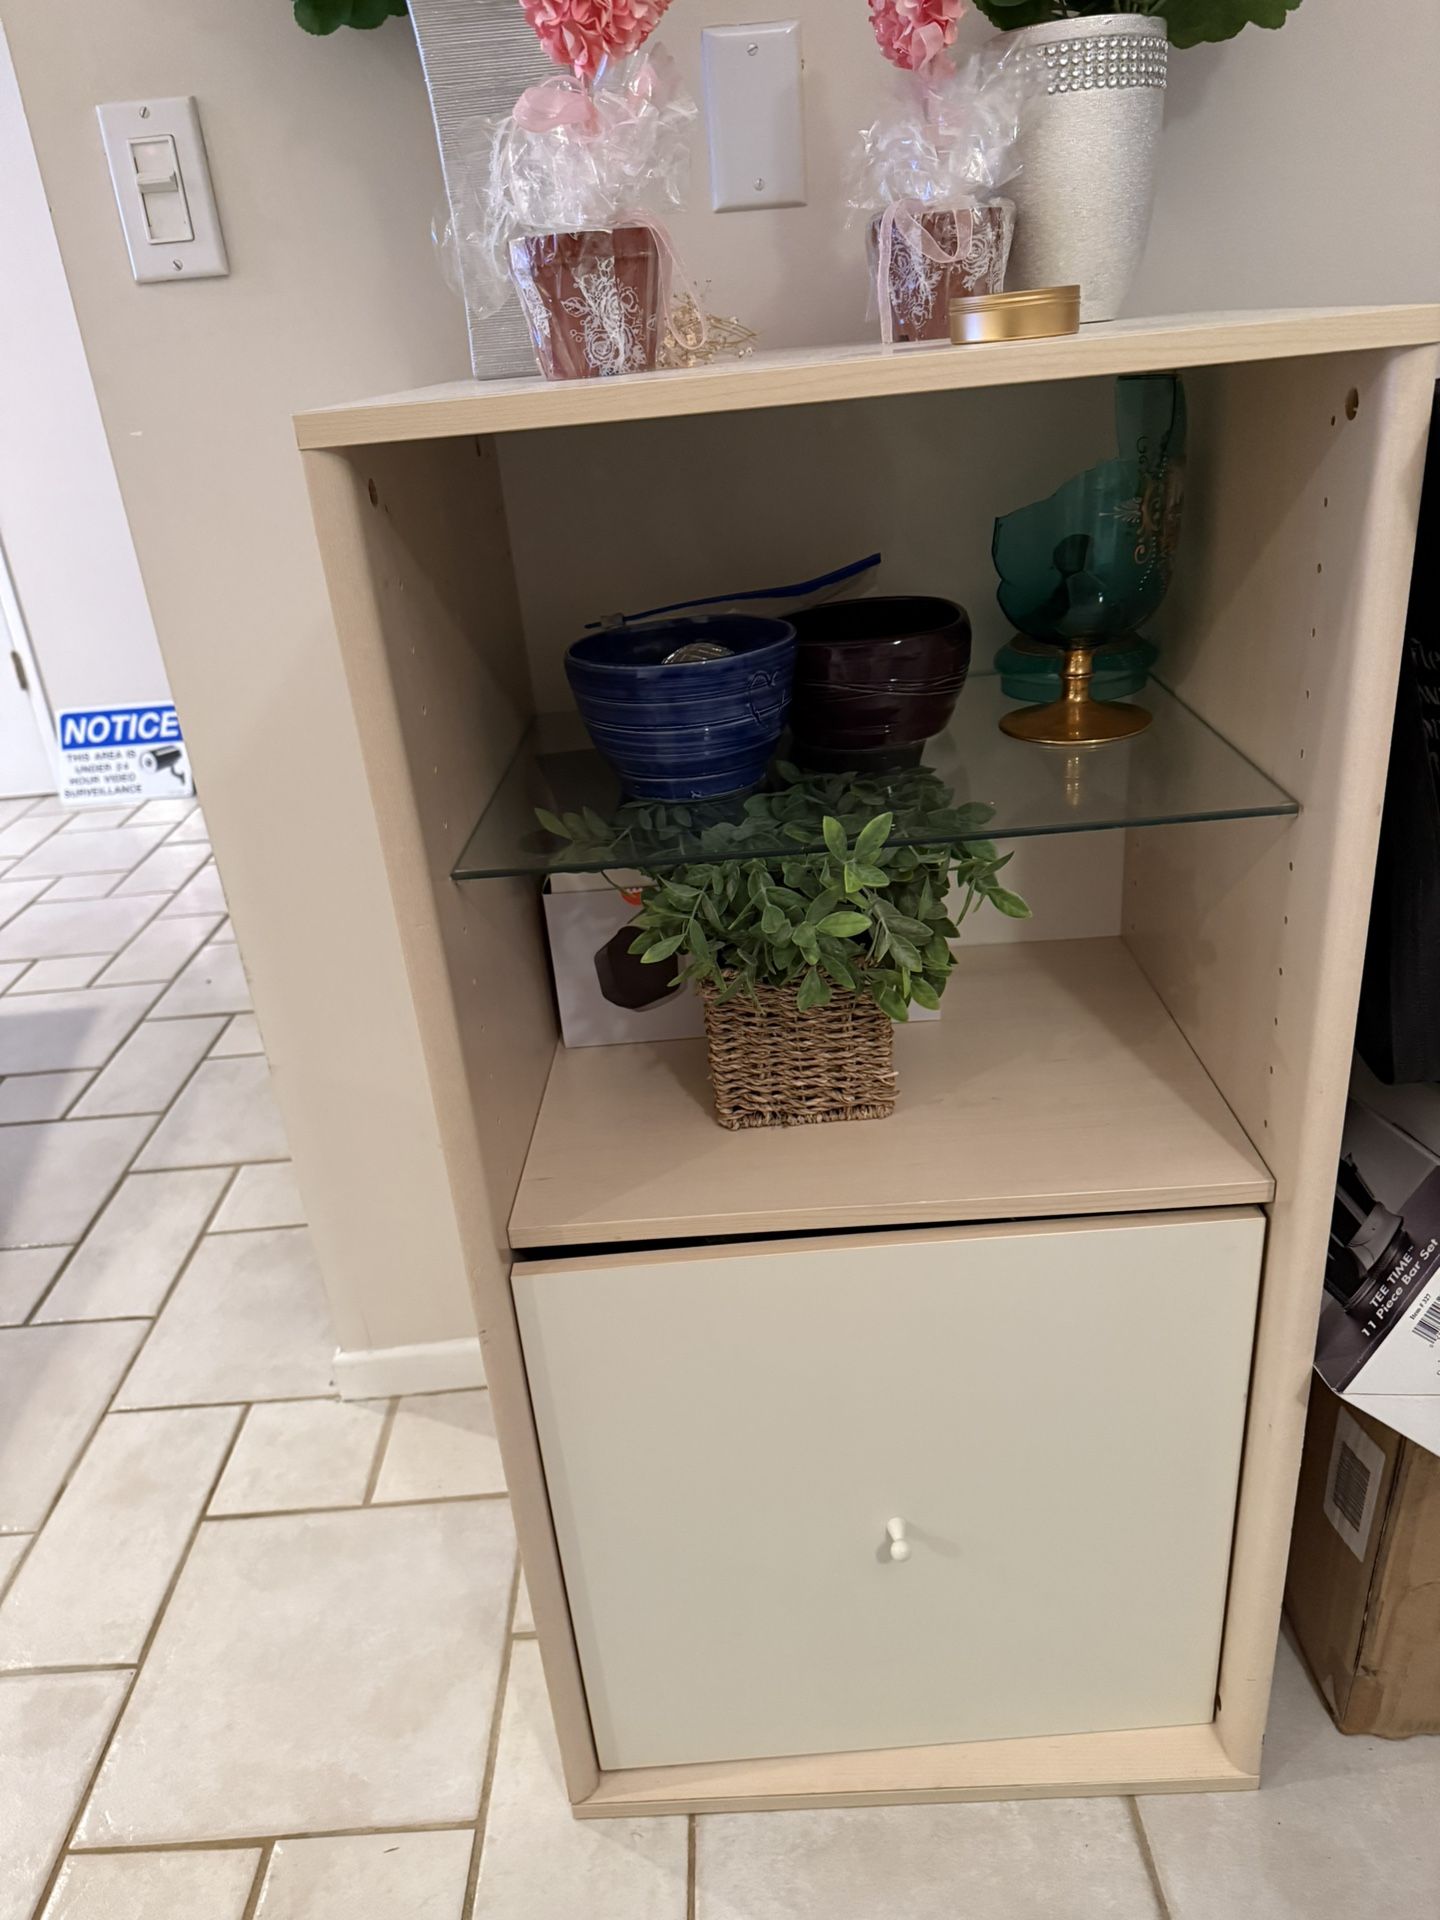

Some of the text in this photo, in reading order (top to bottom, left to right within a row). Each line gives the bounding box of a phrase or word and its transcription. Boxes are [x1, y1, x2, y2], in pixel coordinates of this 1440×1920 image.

[64, 711, 179, 745] NOTICE
[104, 773, 136, 782] VIDEO
[64, 785, 142, 799] SURVEILLANCE
[1375, 1286, 1403, 1320] Piece
[1400, 1260, 1421, 1285] Bar
[1419, 1238, 1438, 1260] Set
[1369, 1284, 1390, 1308] TEE
